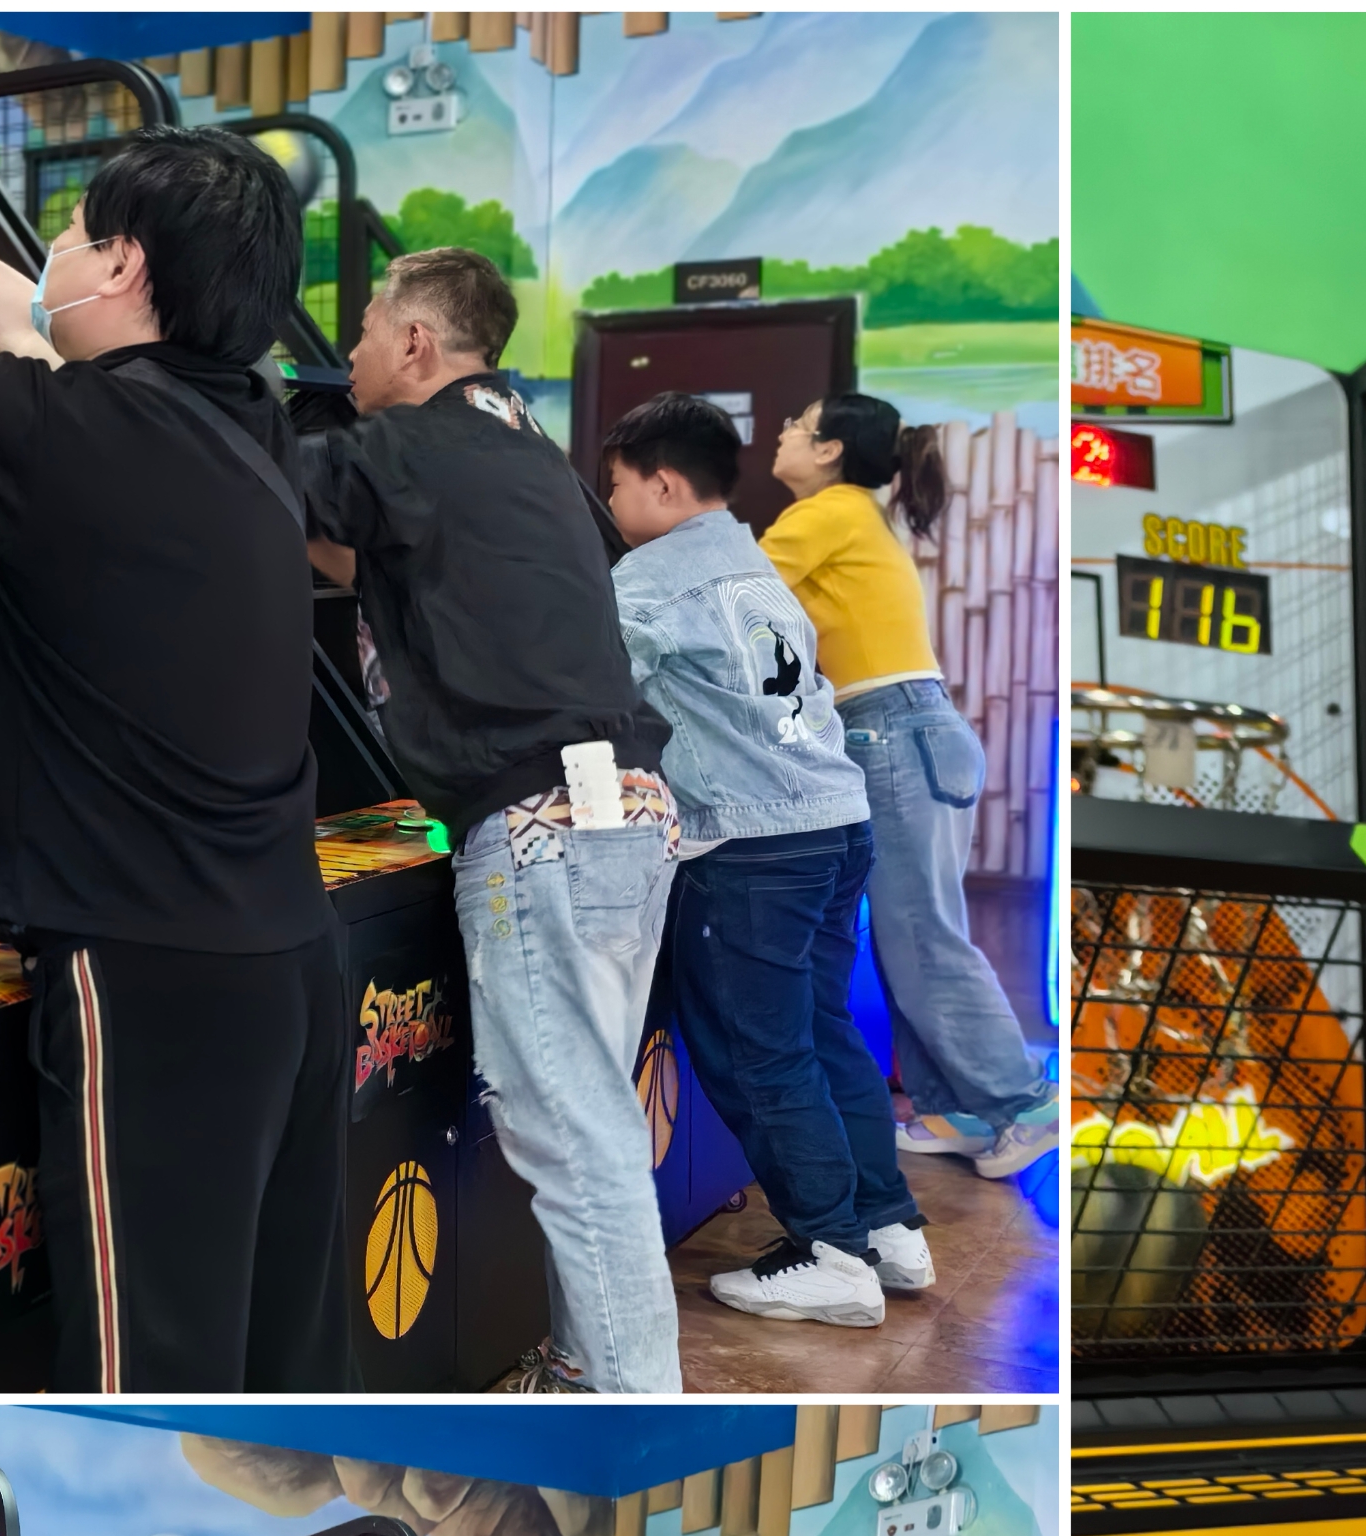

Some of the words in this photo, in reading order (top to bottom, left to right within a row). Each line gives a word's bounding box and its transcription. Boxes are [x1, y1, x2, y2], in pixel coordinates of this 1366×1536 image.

[1072, 423, 1112, 488] 2
[1143, 513, 1247, 570] SCORE
[1145, 576, 1261, 654] 116
